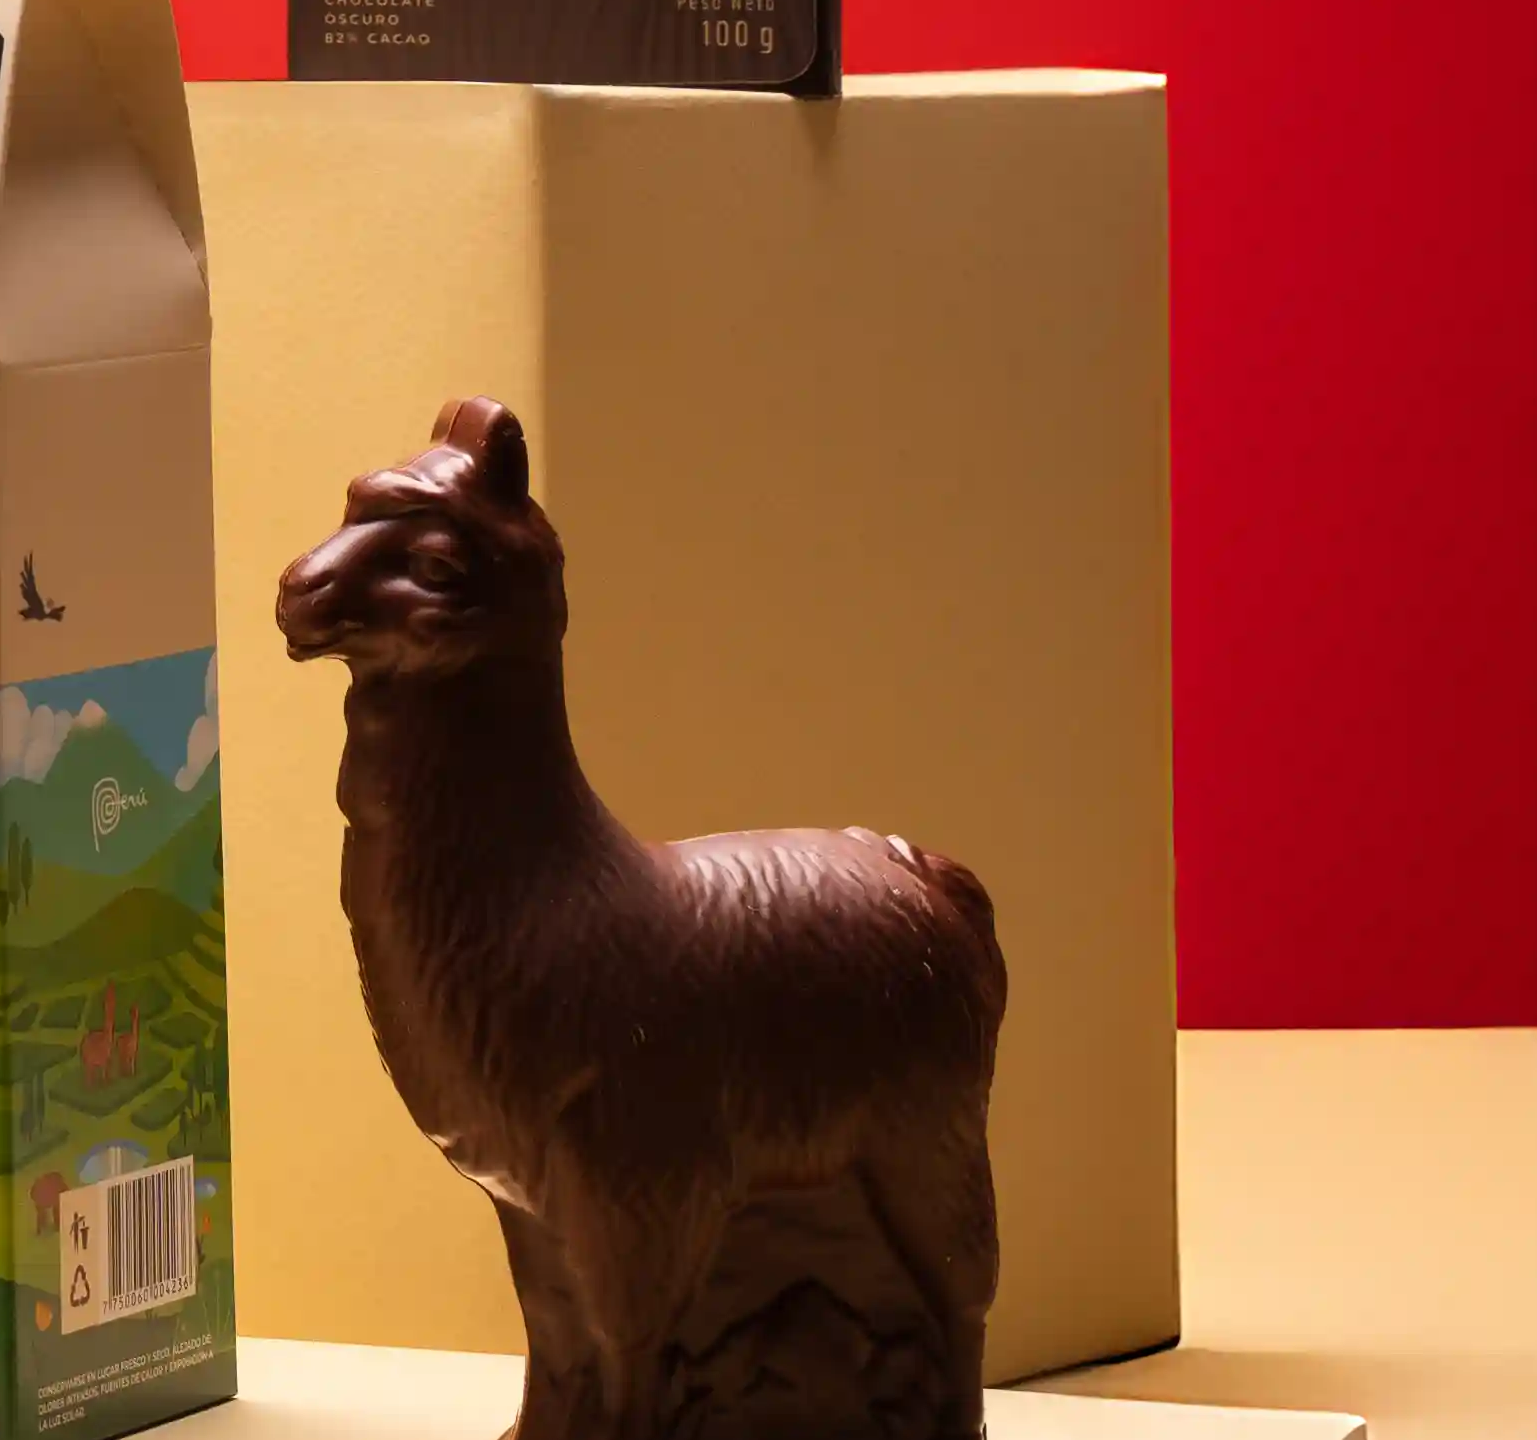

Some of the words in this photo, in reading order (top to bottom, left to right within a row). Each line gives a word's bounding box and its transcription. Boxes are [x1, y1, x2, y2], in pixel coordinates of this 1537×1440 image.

[324, 13, 399, 26] OSCURO
[366, 33, 431, 45] CACAO
[701, 20, 749, 47] 100
[759, 25, 775, 54] g
